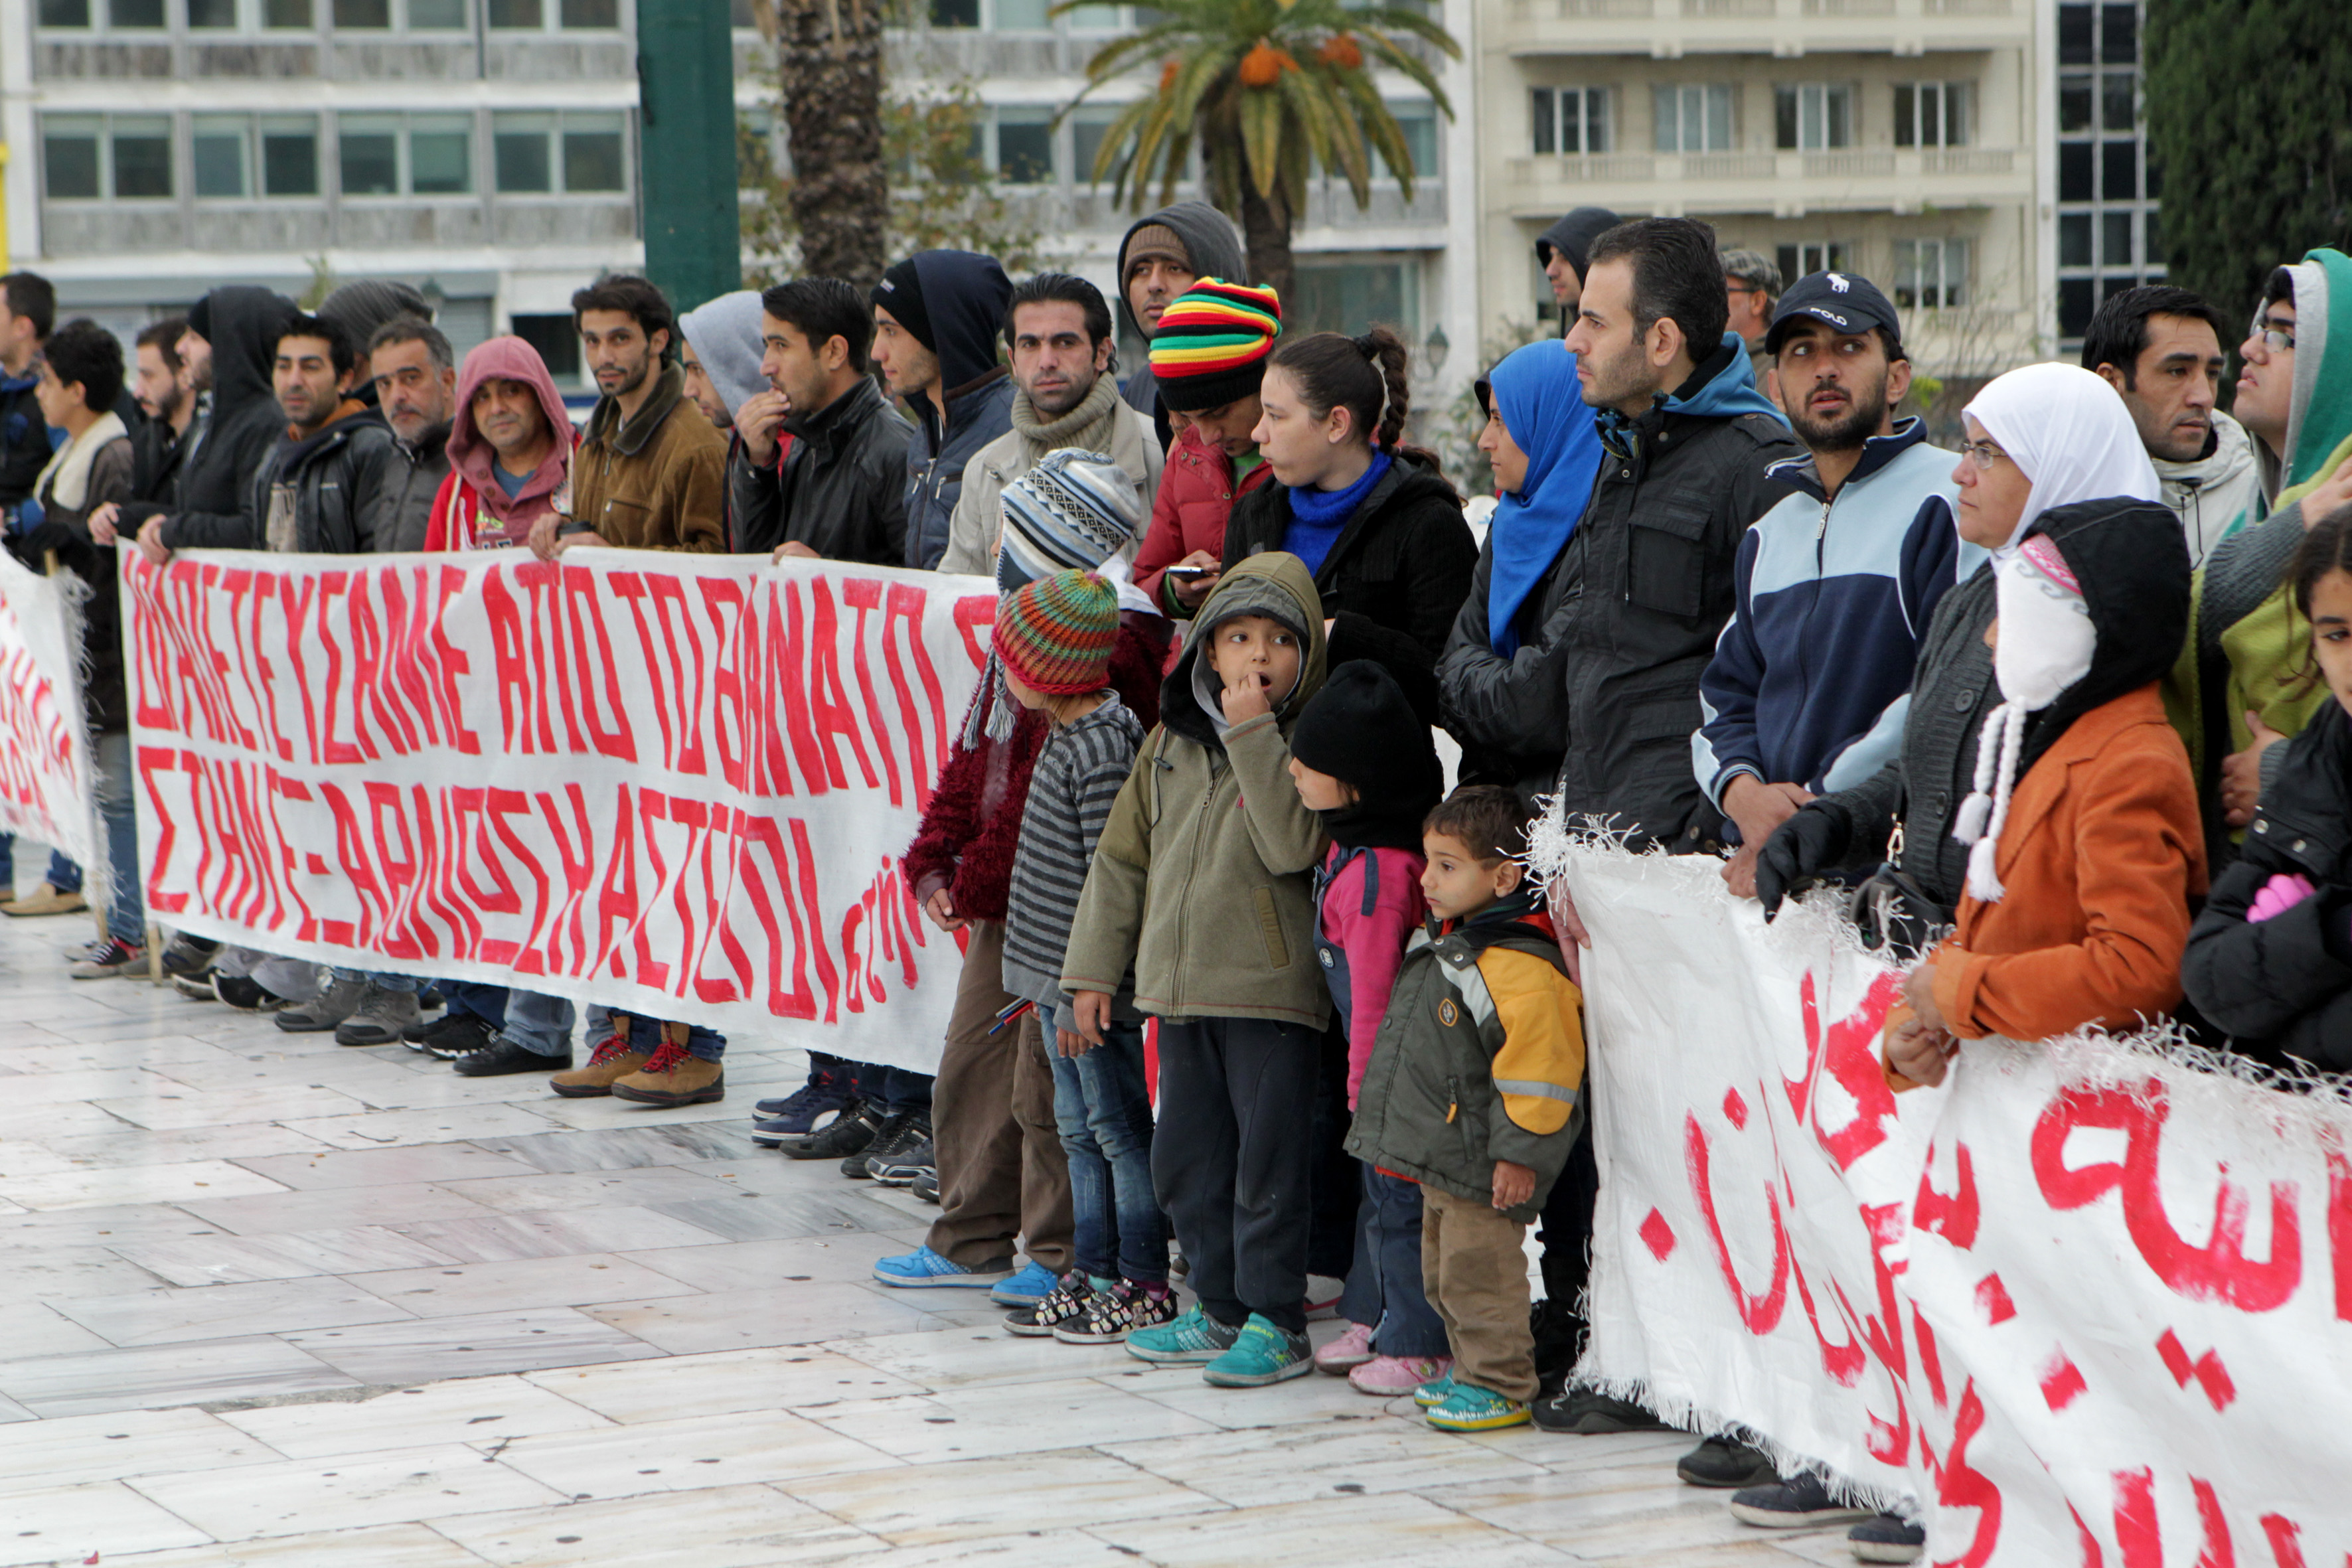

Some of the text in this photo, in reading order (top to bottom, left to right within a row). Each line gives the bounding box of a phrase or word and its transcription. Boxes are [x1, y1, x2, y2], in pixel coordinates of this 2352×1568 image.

[1810, 307, 1848, 326] POLO
[482, 560, 638, 763] ΑΠΟ
[607, 571, 708, 776] ΤΟ
